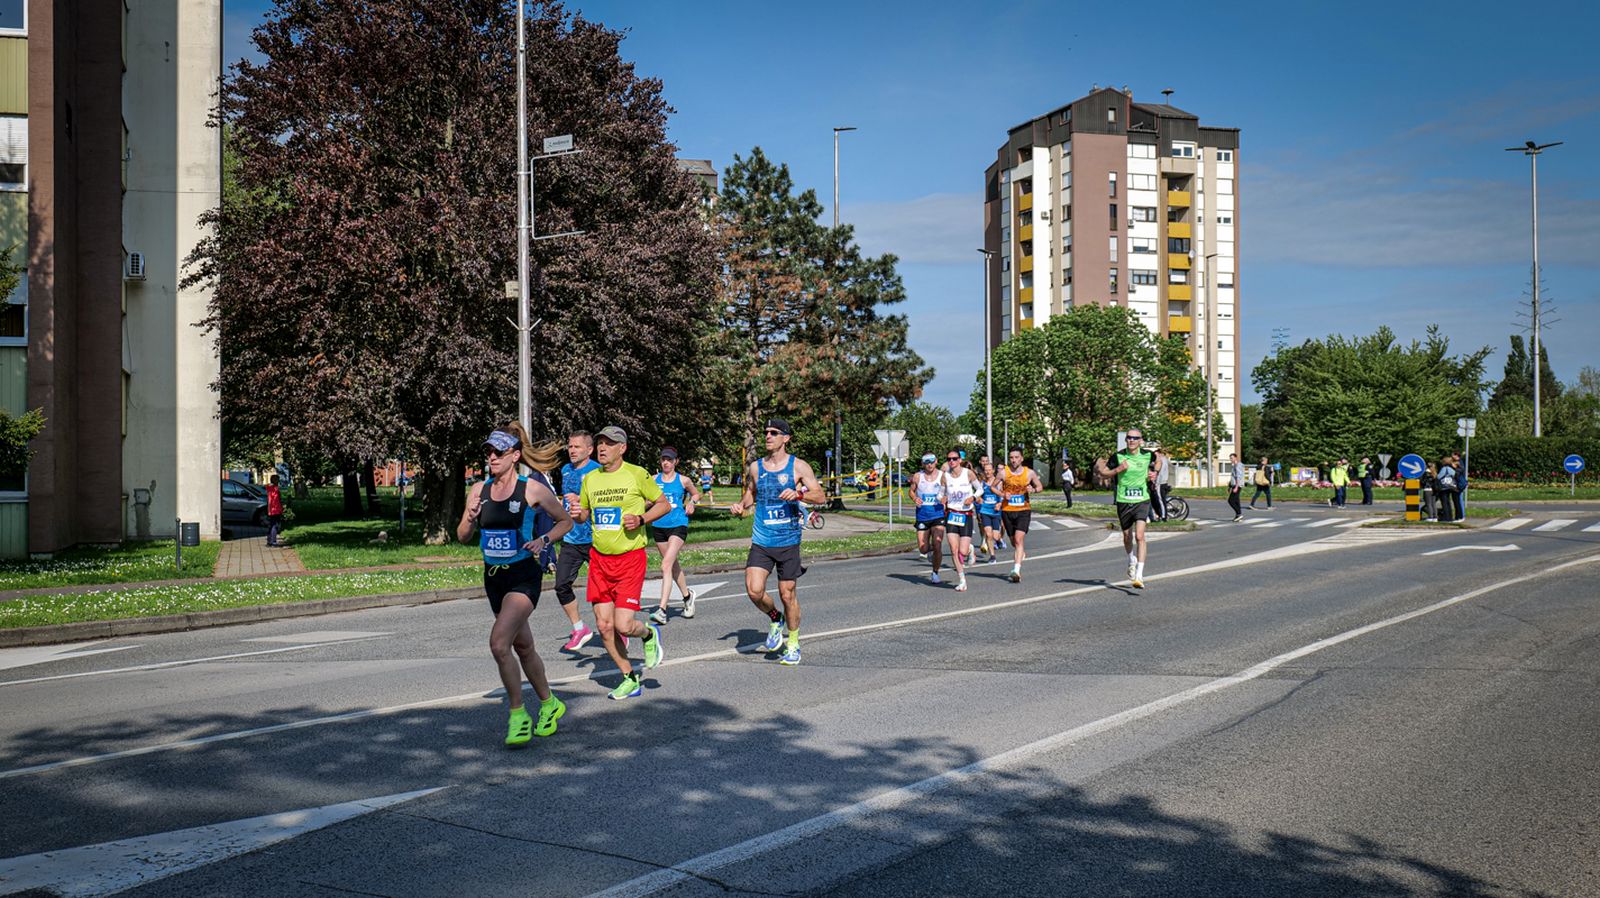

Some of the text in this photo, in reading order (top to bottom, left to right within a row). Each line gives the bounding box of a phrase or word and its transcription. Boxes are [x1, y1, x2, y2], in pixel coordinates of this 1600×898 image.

[597, 495, 624, 503] MARATON
[597, 513, 616, 524] 167
[767, 509, 786, 519] 113
[487, 537, 511, 549] 483
